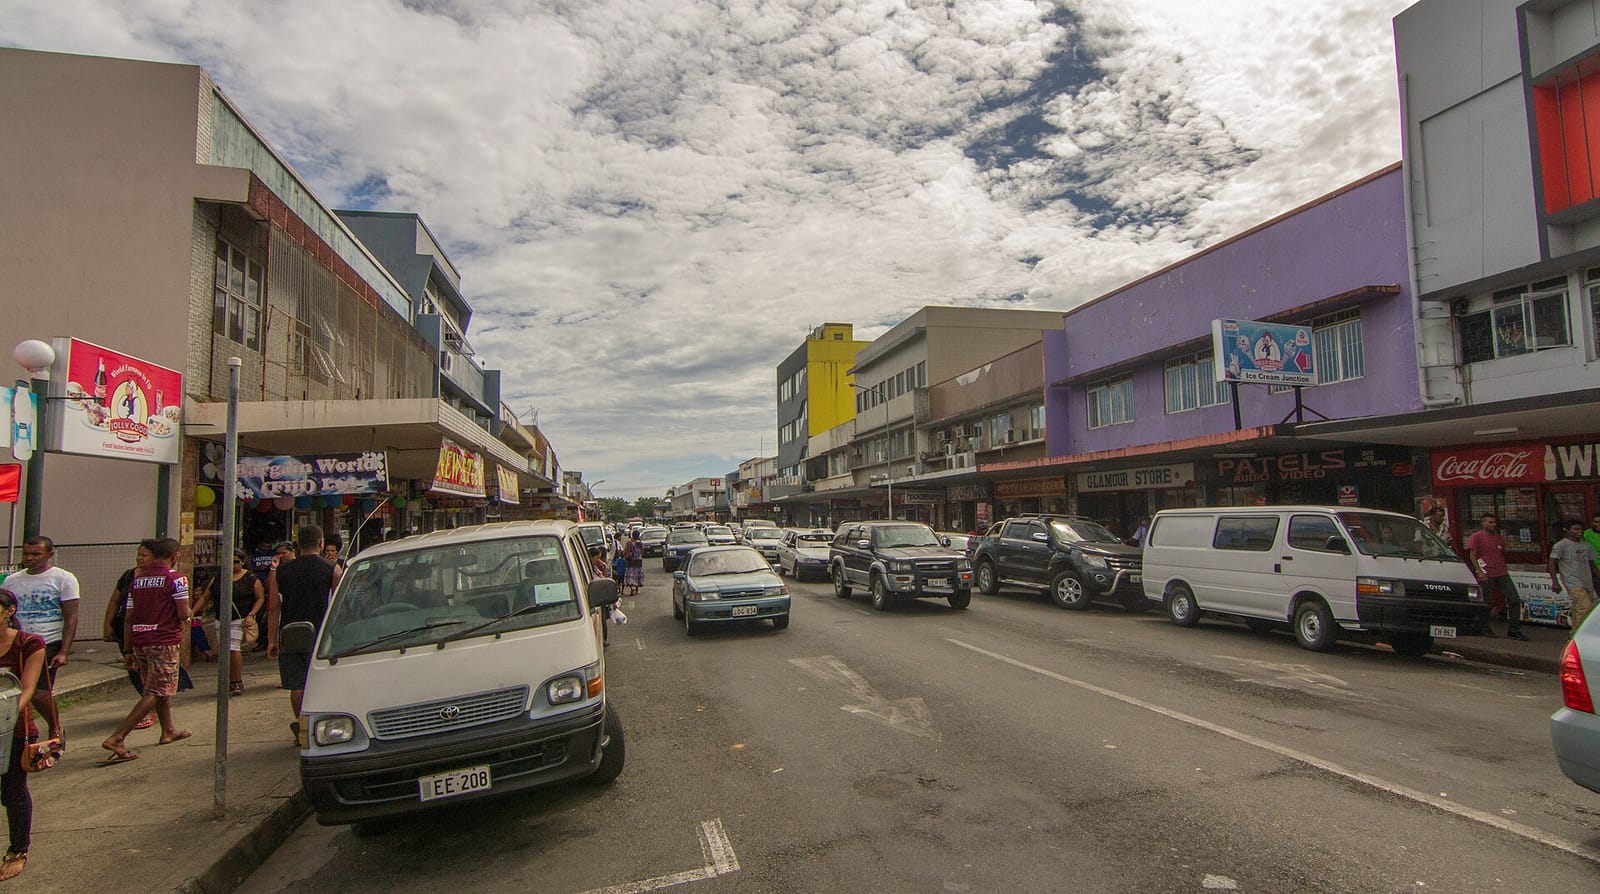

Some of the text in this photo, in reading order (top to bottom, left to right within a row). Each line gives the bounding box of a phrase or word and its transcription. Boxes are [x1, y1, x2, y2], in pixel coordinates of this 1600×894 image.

[1258, 373, 1280, 381] Cream
[1281, 374, 1310, 383] Junction
[316, 455, 376, 474] World
[1218, 450, 1345, 476] PATELS
[1437, 451, 1532, 481] Coca-Cola
[1087, 469, 1171, 488] GLAMOUR STORE
[1233, 469, 1325, 482] AUDIO VIDEO
